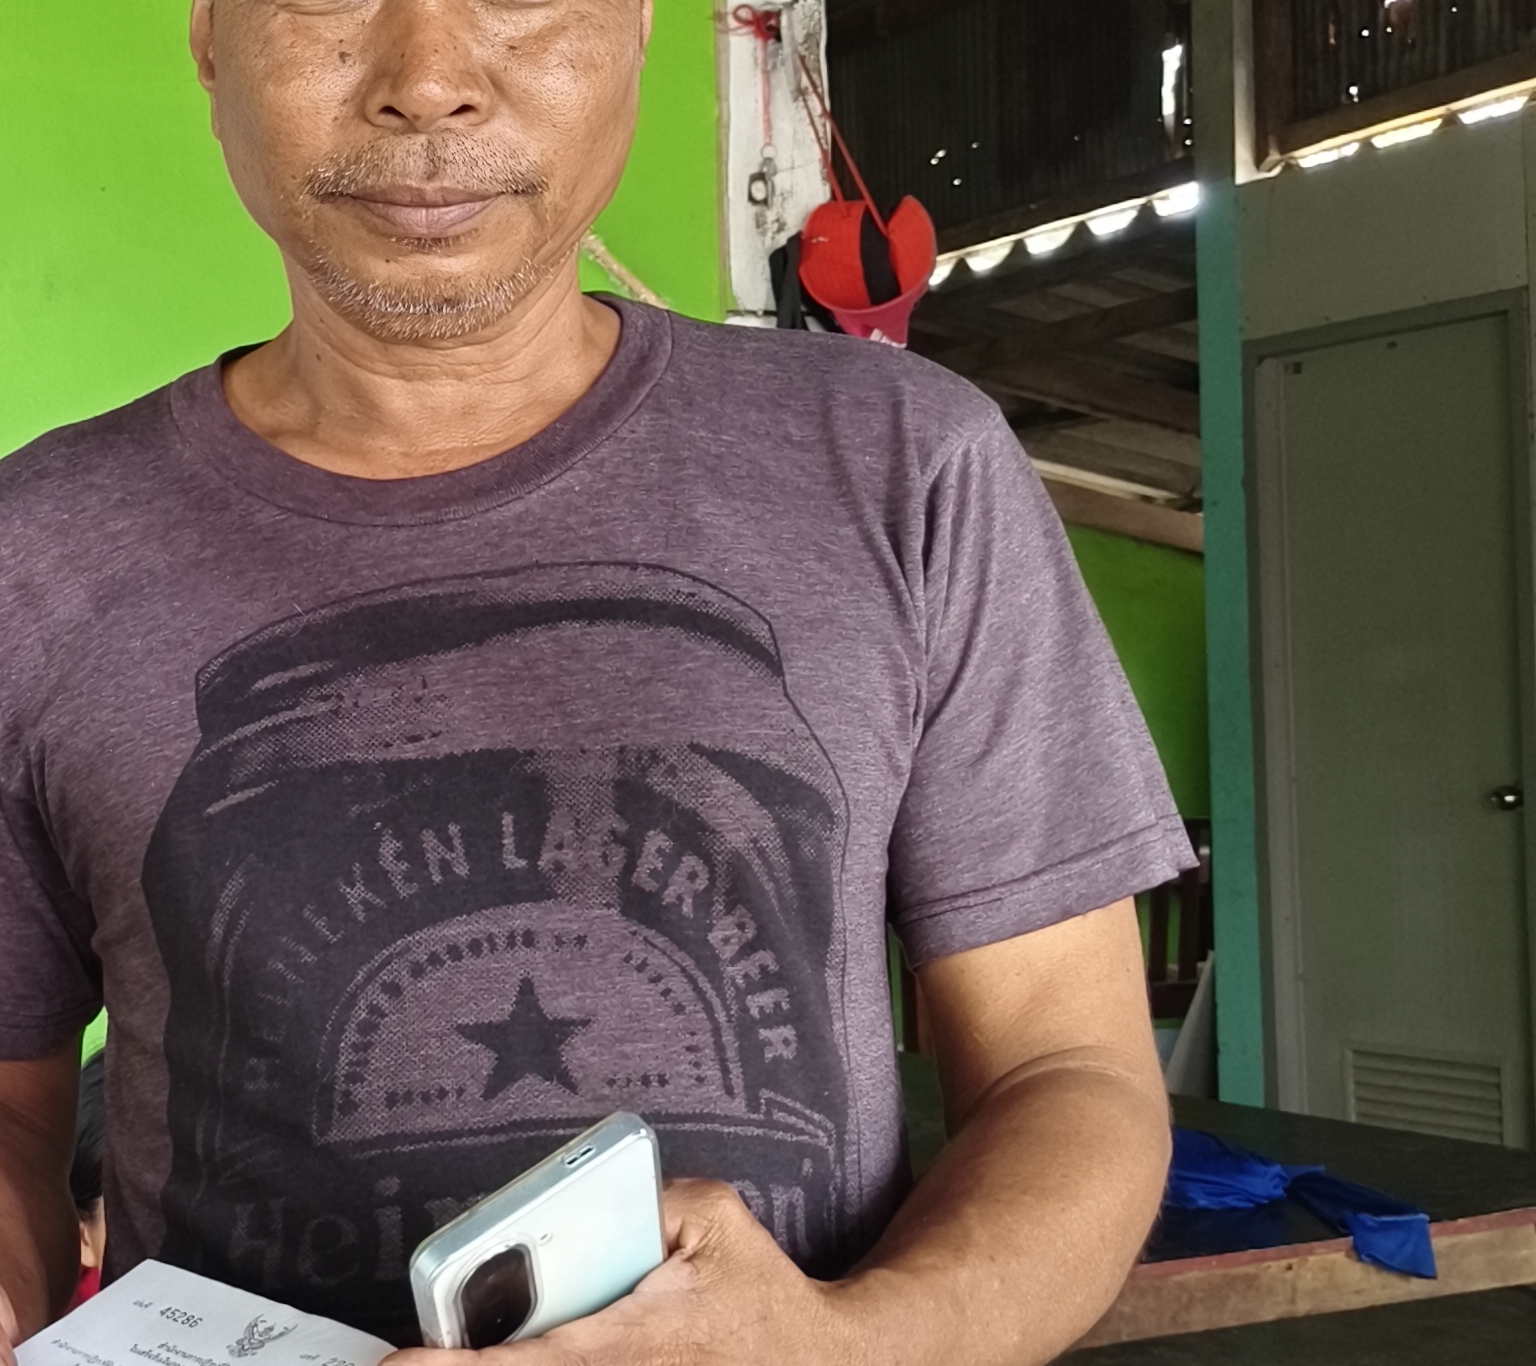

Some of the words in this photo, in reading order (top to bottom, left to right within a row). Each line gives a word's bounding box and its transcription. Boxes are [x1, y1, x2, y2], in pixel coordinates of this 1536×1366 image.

[500, 811, 713, 918] LAGER
[707, 903, 799, 1061] BEER
[158, 1305, 203, 1328] 45286
